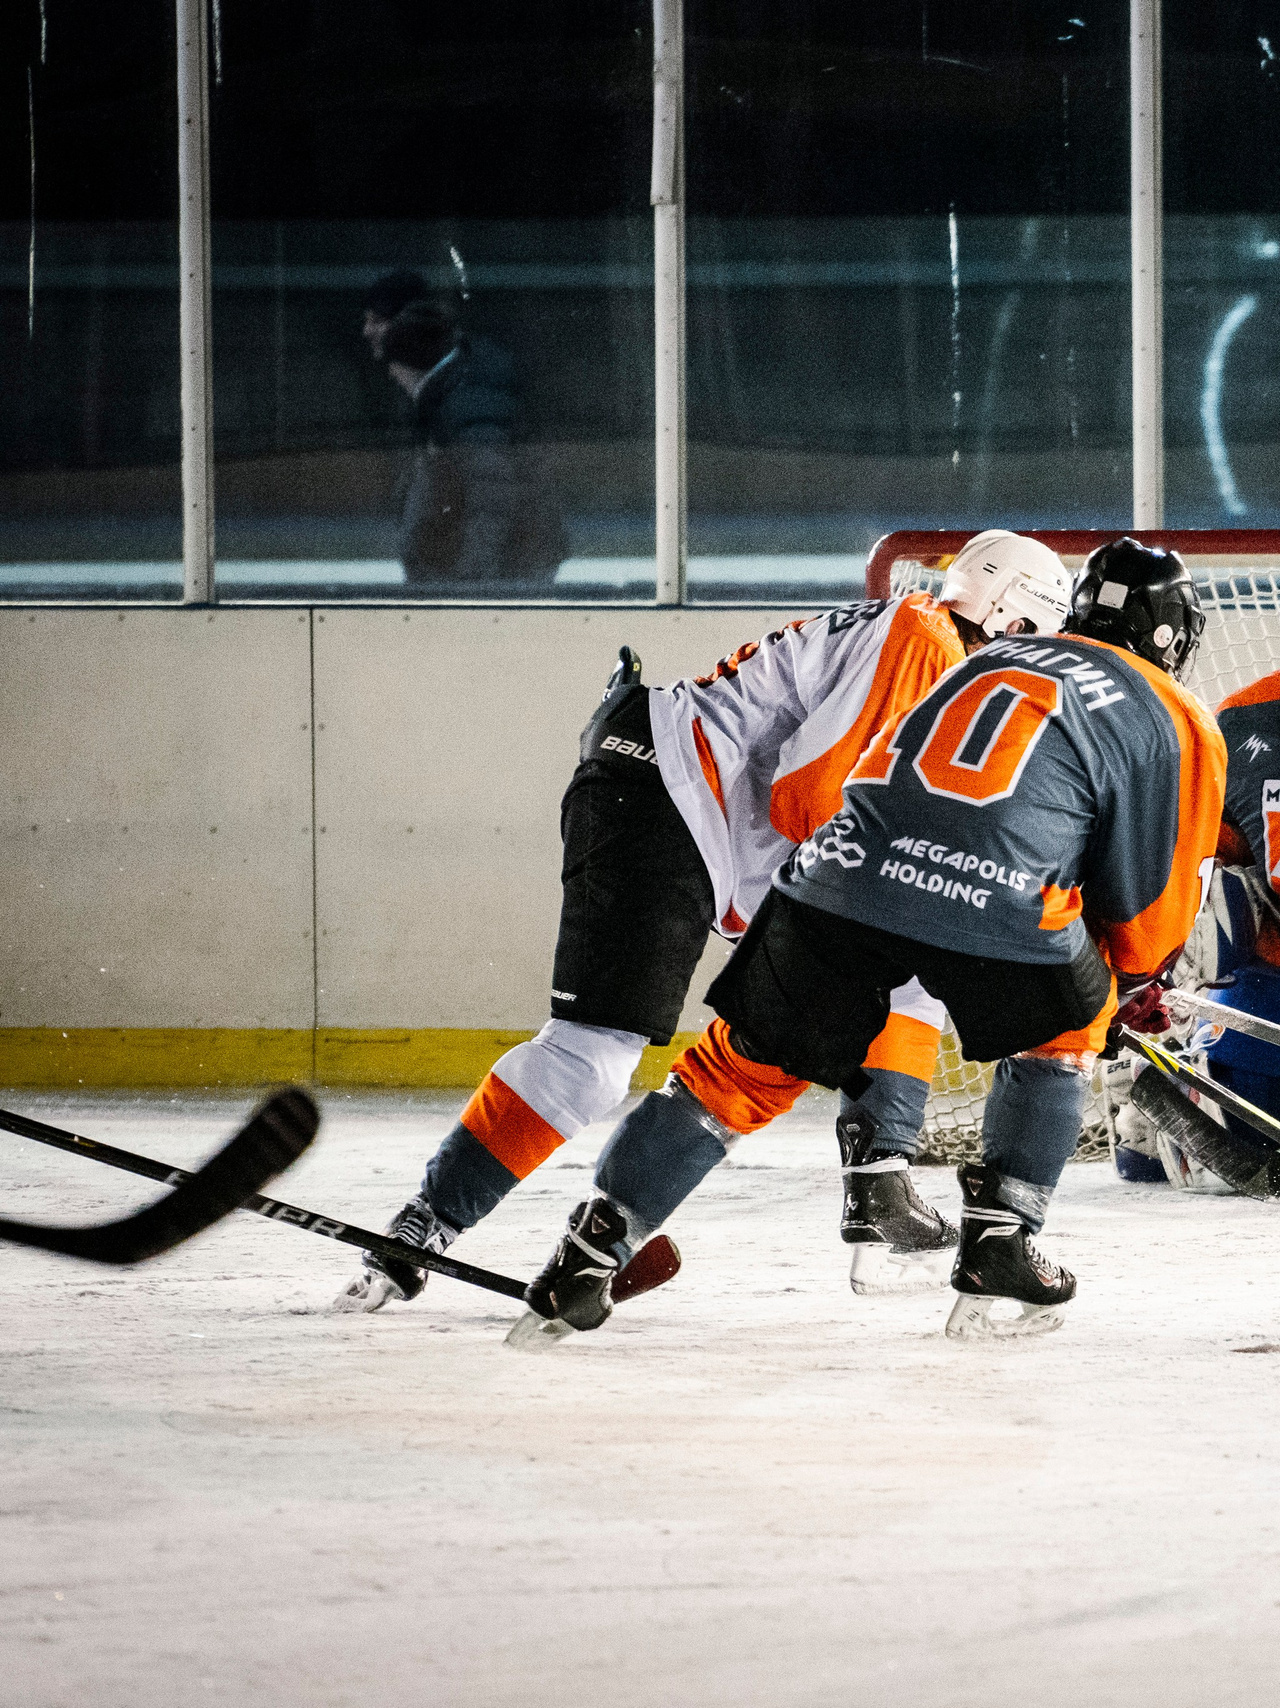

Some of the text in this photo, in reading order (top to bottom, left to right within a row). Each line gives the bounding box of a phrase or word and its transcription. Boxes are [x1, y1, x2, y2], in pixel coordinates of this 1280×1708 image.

[600, 735, 659, 766] BAU
[889, 836, 1031, 892] MEGAPOLIS
[879, 859, 993, 909] HOLDING
[551, 988, 577, 1002] AUER
[1107, 1059, 1131, 1074] EFLE
